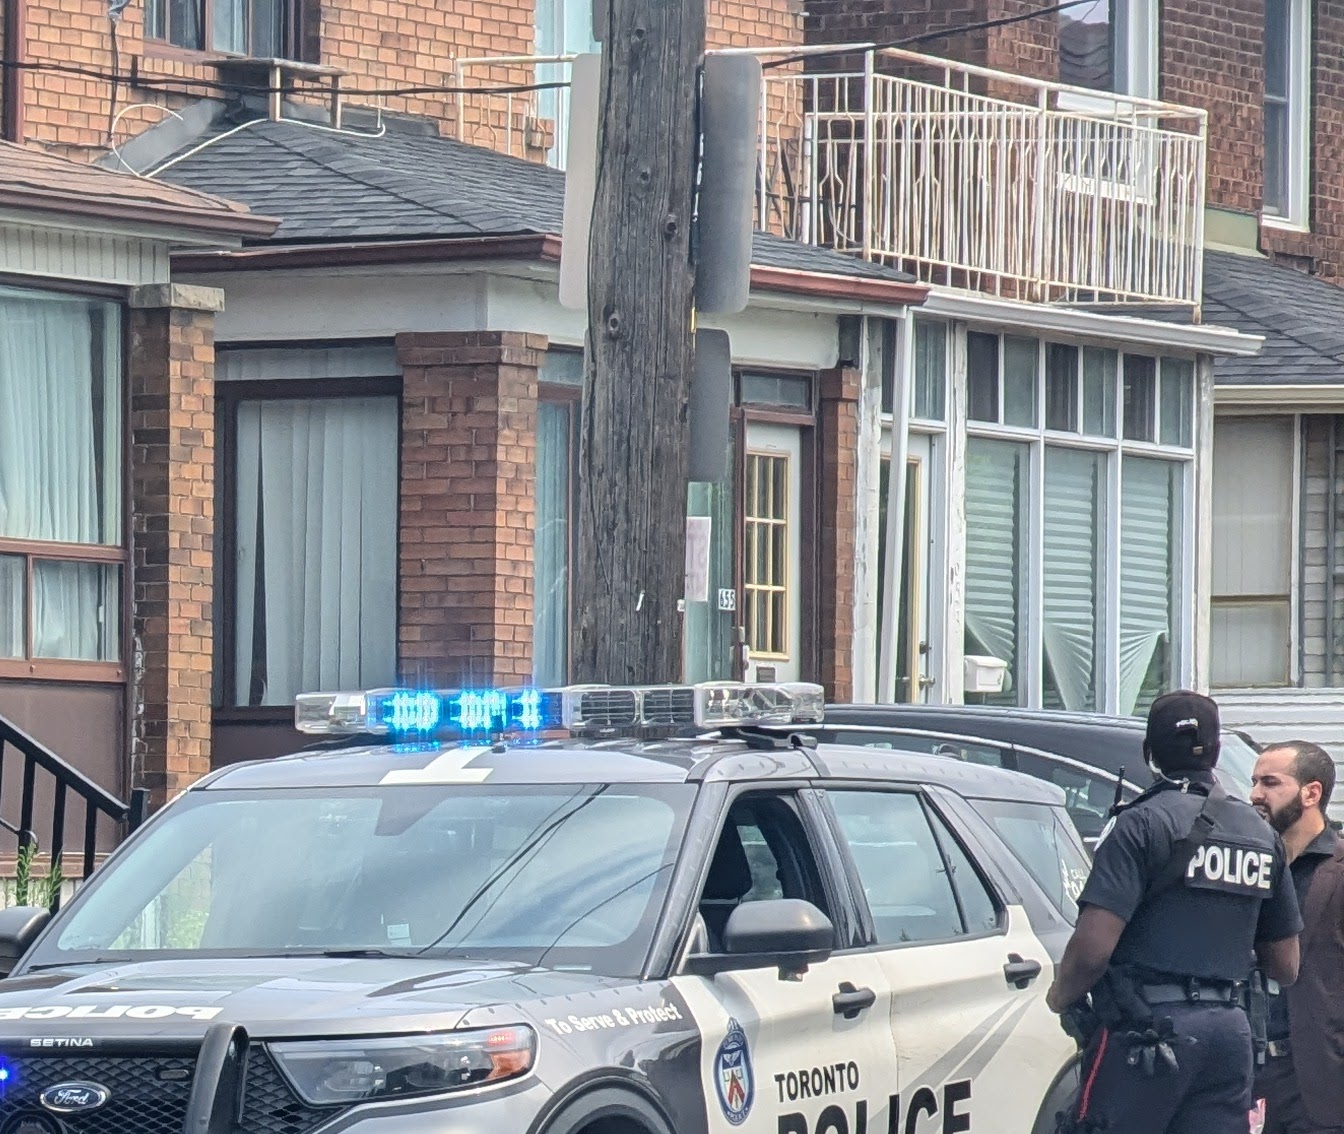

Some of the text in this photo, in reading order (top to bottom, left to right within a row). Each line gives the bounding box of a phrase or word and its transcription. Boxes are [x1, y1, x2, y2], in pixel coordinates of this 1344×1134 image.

[720, 590, 735, 609] 655
[1187, 845, 1273, 889] POLICE
[545, 1003, 683, 1035] To Serve & Protect
[30, 1038, 94, 1047] SETINA
[774, 1060, 860, 1103] TORONTO
